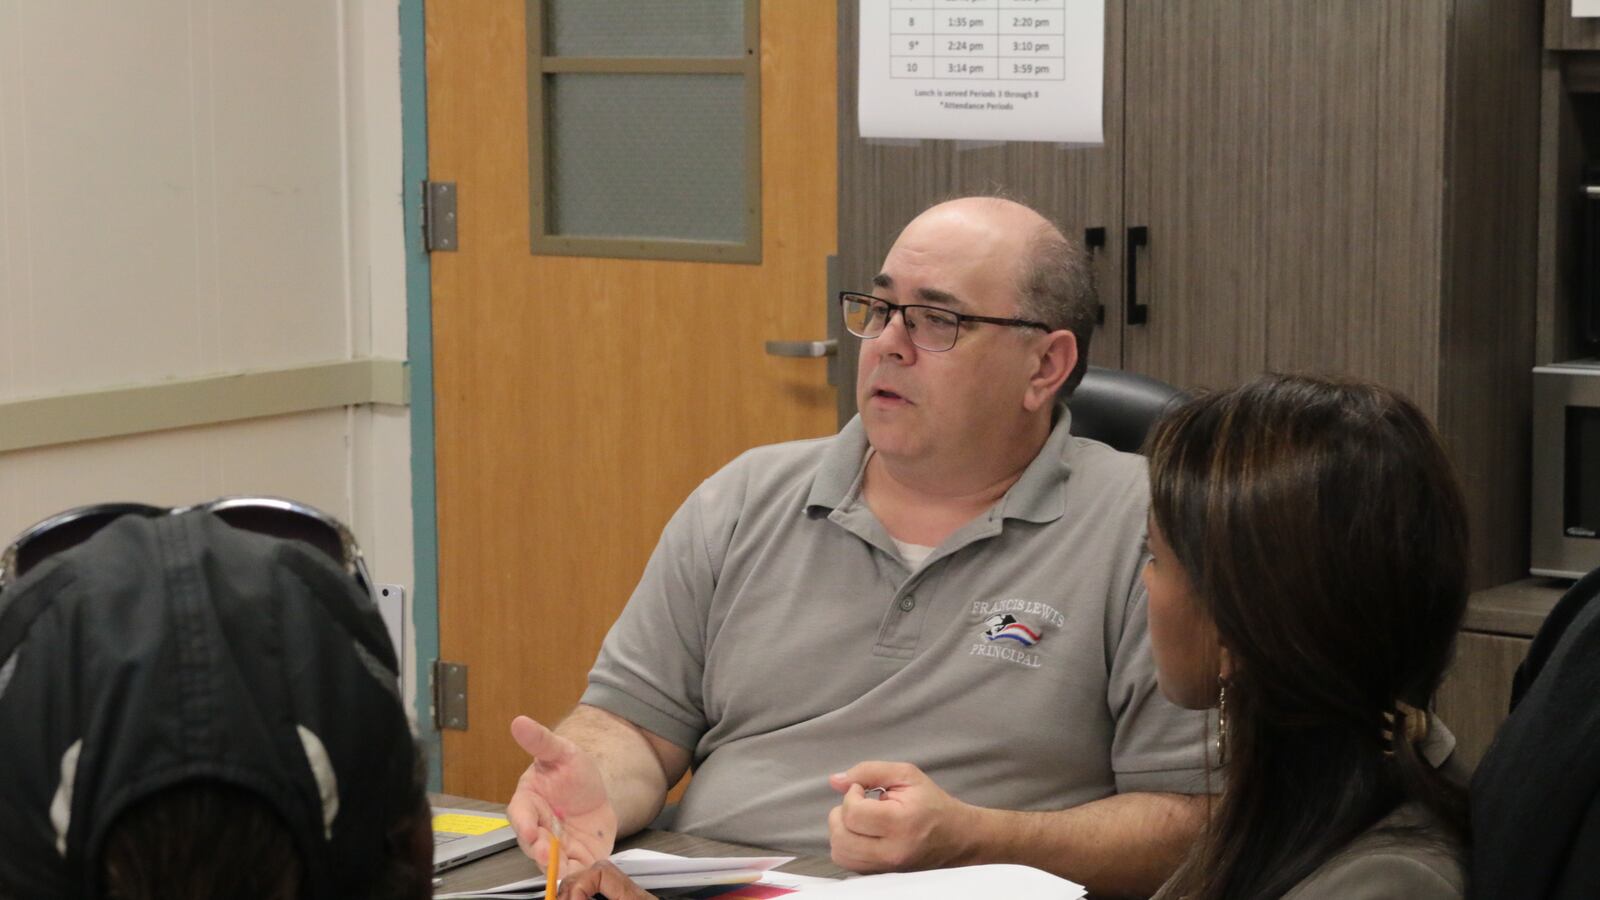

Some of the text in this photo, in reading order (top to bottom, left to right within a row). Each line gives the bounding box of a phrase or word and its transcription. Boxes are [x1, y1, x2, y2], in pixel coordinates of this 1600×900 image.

[908, 17, 915, 27] 8
[948, 17, 984, 29] 1:35 pm
[1012, 17, 1050, 29] 2:20 pm
[947, 41, 984, 53] 2:24 pm
[1012, 42, 1050, 53] 3:10 pm
[906, 63, 918, 73] 10
[947, 63, 984, 75] 3:14 pm
[1012, 64, 1050, 75] 3:59 pm
[914, 88, 935, 97] Lunch
[937, 89, 943, 97] is
[944, 89, 968, 98] served
[969, 90, 996, 98] Periods
[1004, 90, 1033, 100] through
[986, 102, 1014, 111] Periods
[971, 598, 1065, 628] FRANCIS LEWIS
[970, 643, 1042, 668] PRINCIPAL
